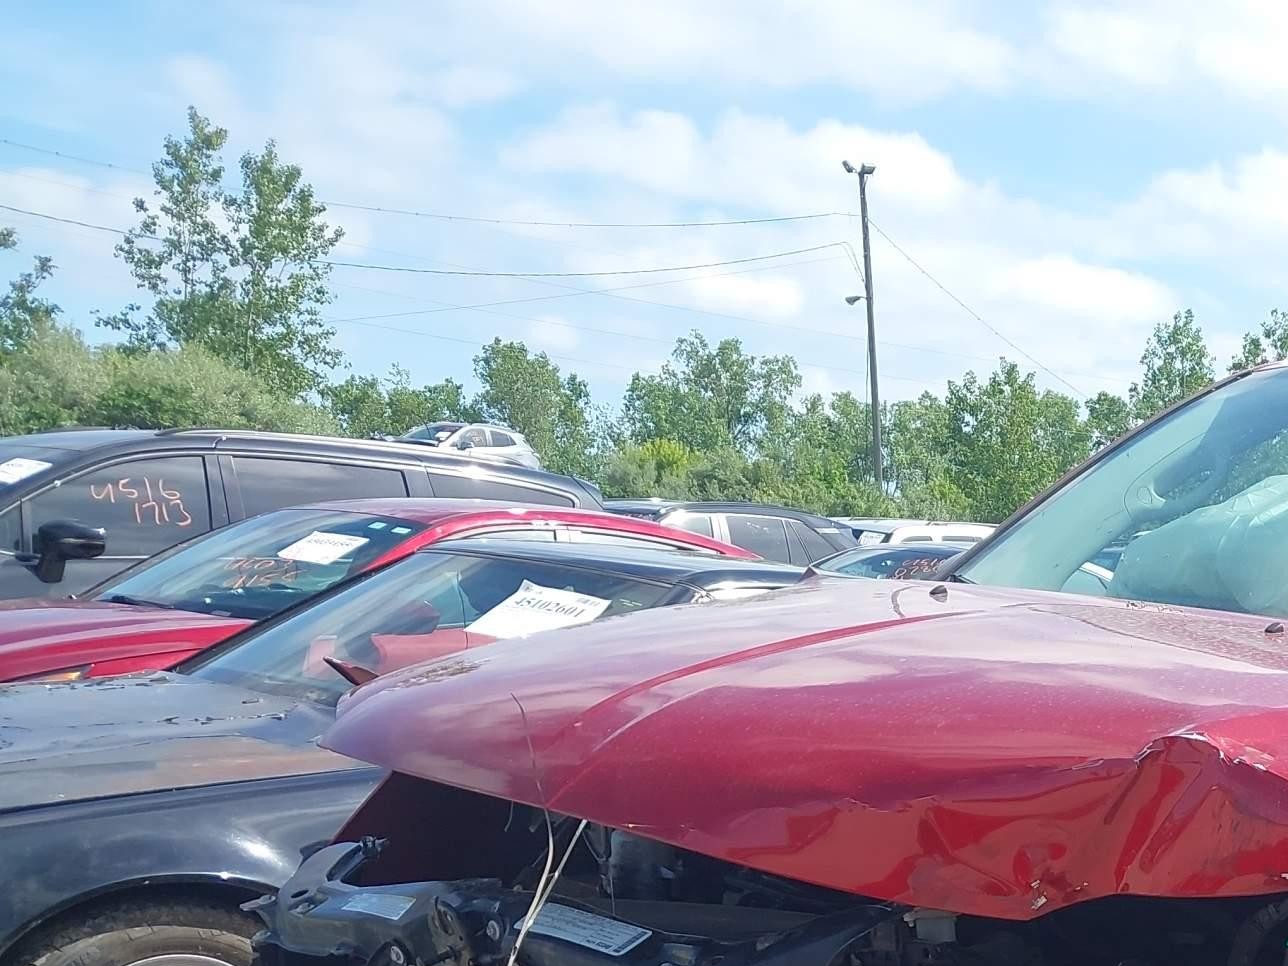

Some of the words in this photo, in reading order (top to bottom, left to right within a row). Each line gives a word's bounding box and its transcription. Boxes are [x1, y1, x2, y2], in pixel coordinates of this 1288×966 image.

[90, 477, 181, 503] 4516
[135, 499, 192, 526] 1713
[514, 597, 585, 618] 45102601
